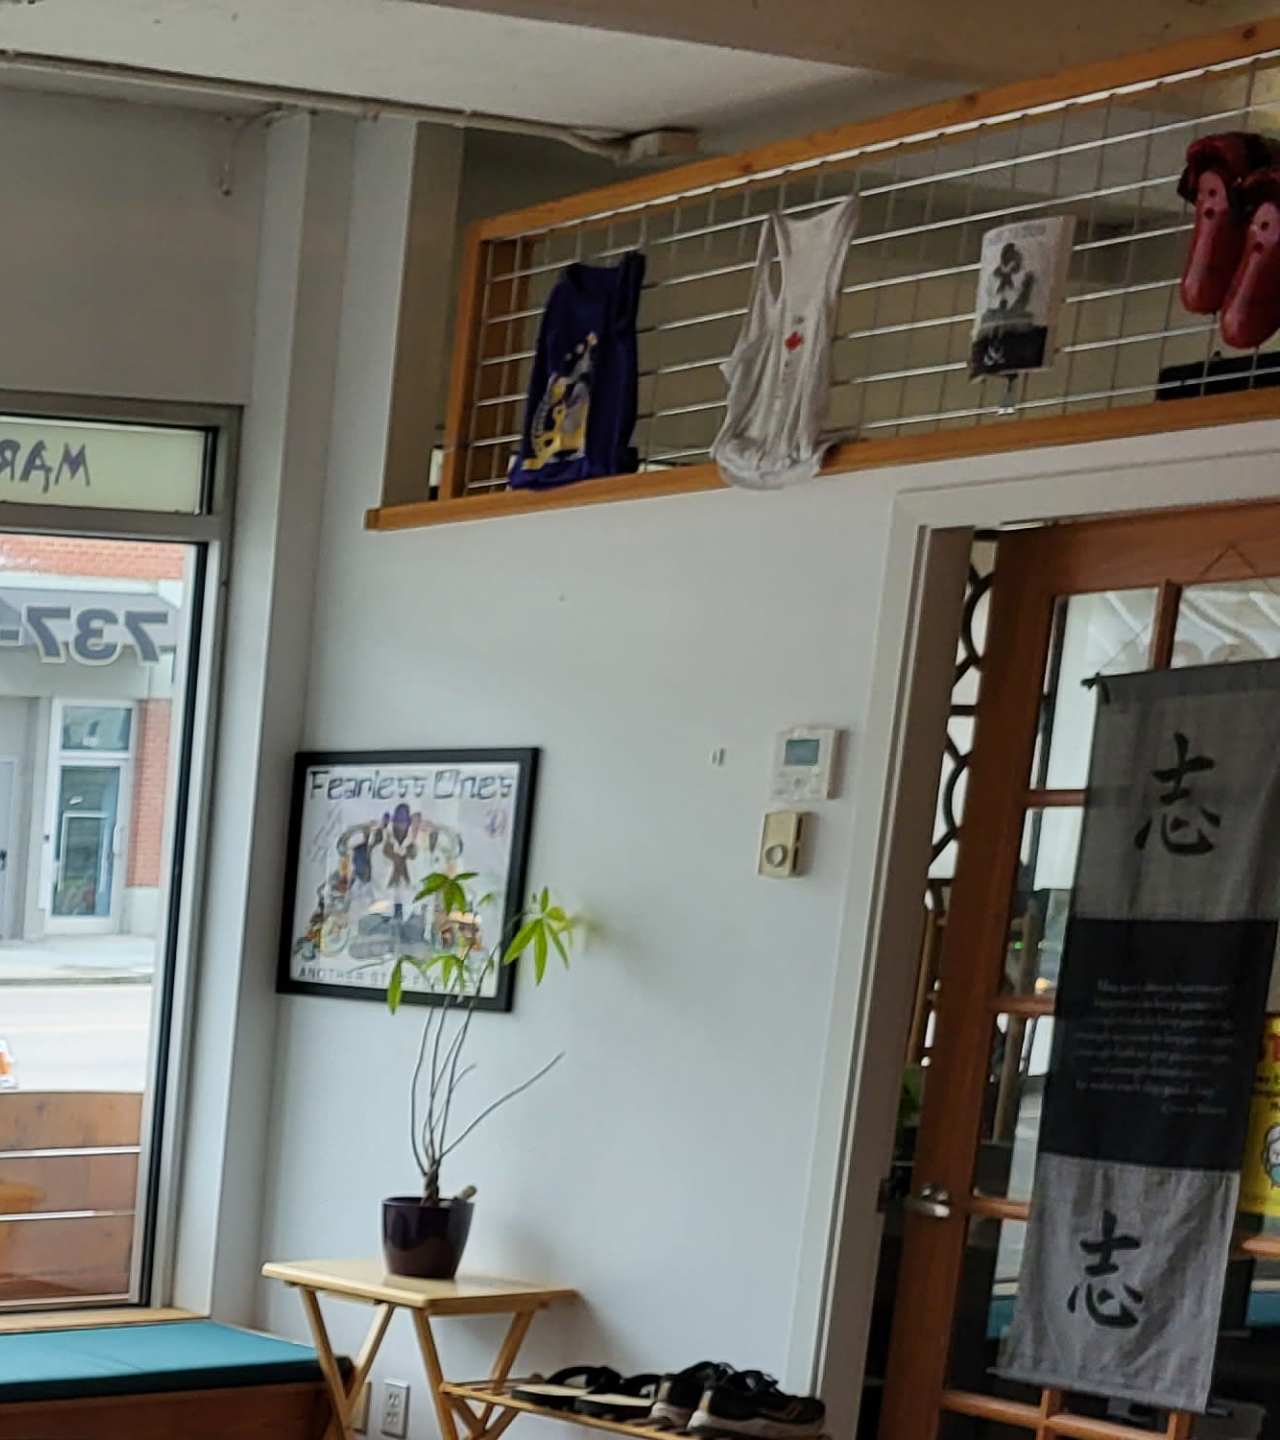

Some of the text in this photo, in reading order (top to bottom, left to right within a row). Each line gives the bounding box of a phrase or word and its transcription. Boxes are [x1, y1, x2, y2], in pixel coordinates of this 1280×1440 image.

[307, 769, 515, 800] Fearless Ones
[1133, 730, 1221, 858] 志
[1067, 1209, 1143, 1330] 志
